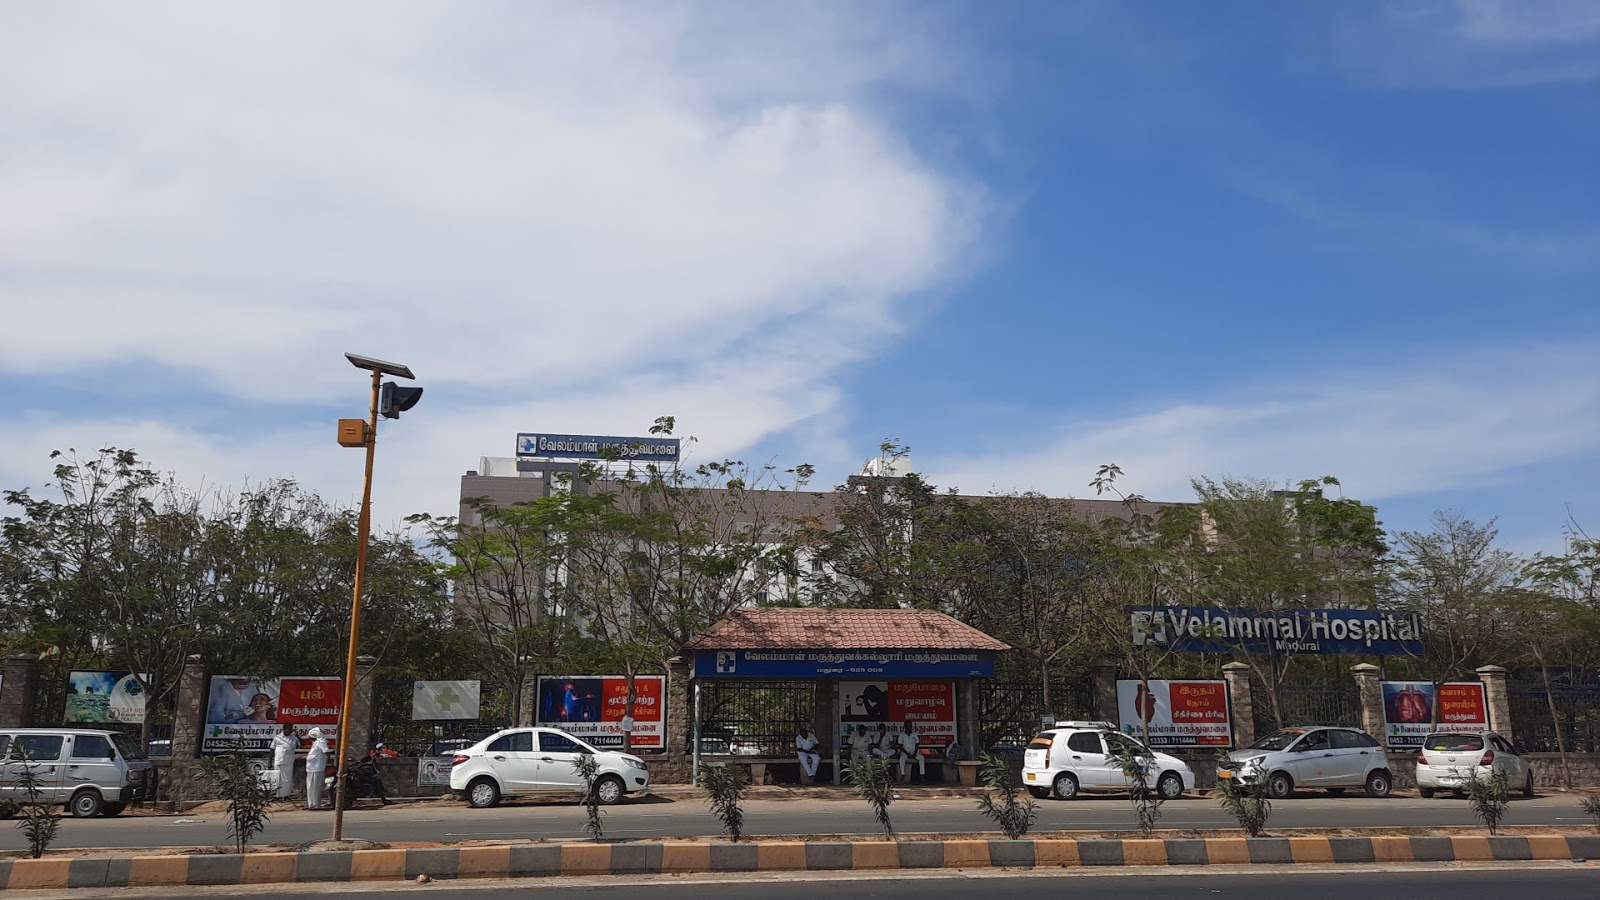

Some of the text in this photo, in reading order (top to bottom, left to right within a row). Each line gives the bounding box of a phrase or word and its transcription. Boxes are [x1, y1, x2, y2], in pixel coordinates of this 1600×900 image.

[539, 437, 598, 453] வேலம்மாள்
[1167, 608, 1421, 647] Velammal Hospital
[1275, 639, 1320, 651] Madurai
[744, 650, 978, 664] வேலம்மாள் மருத்துவக்கல்லூரி மருத்துவமனை
[299, 686, 325, 700] பல்
[281, 705, 340, 717] மருத்துவம்
